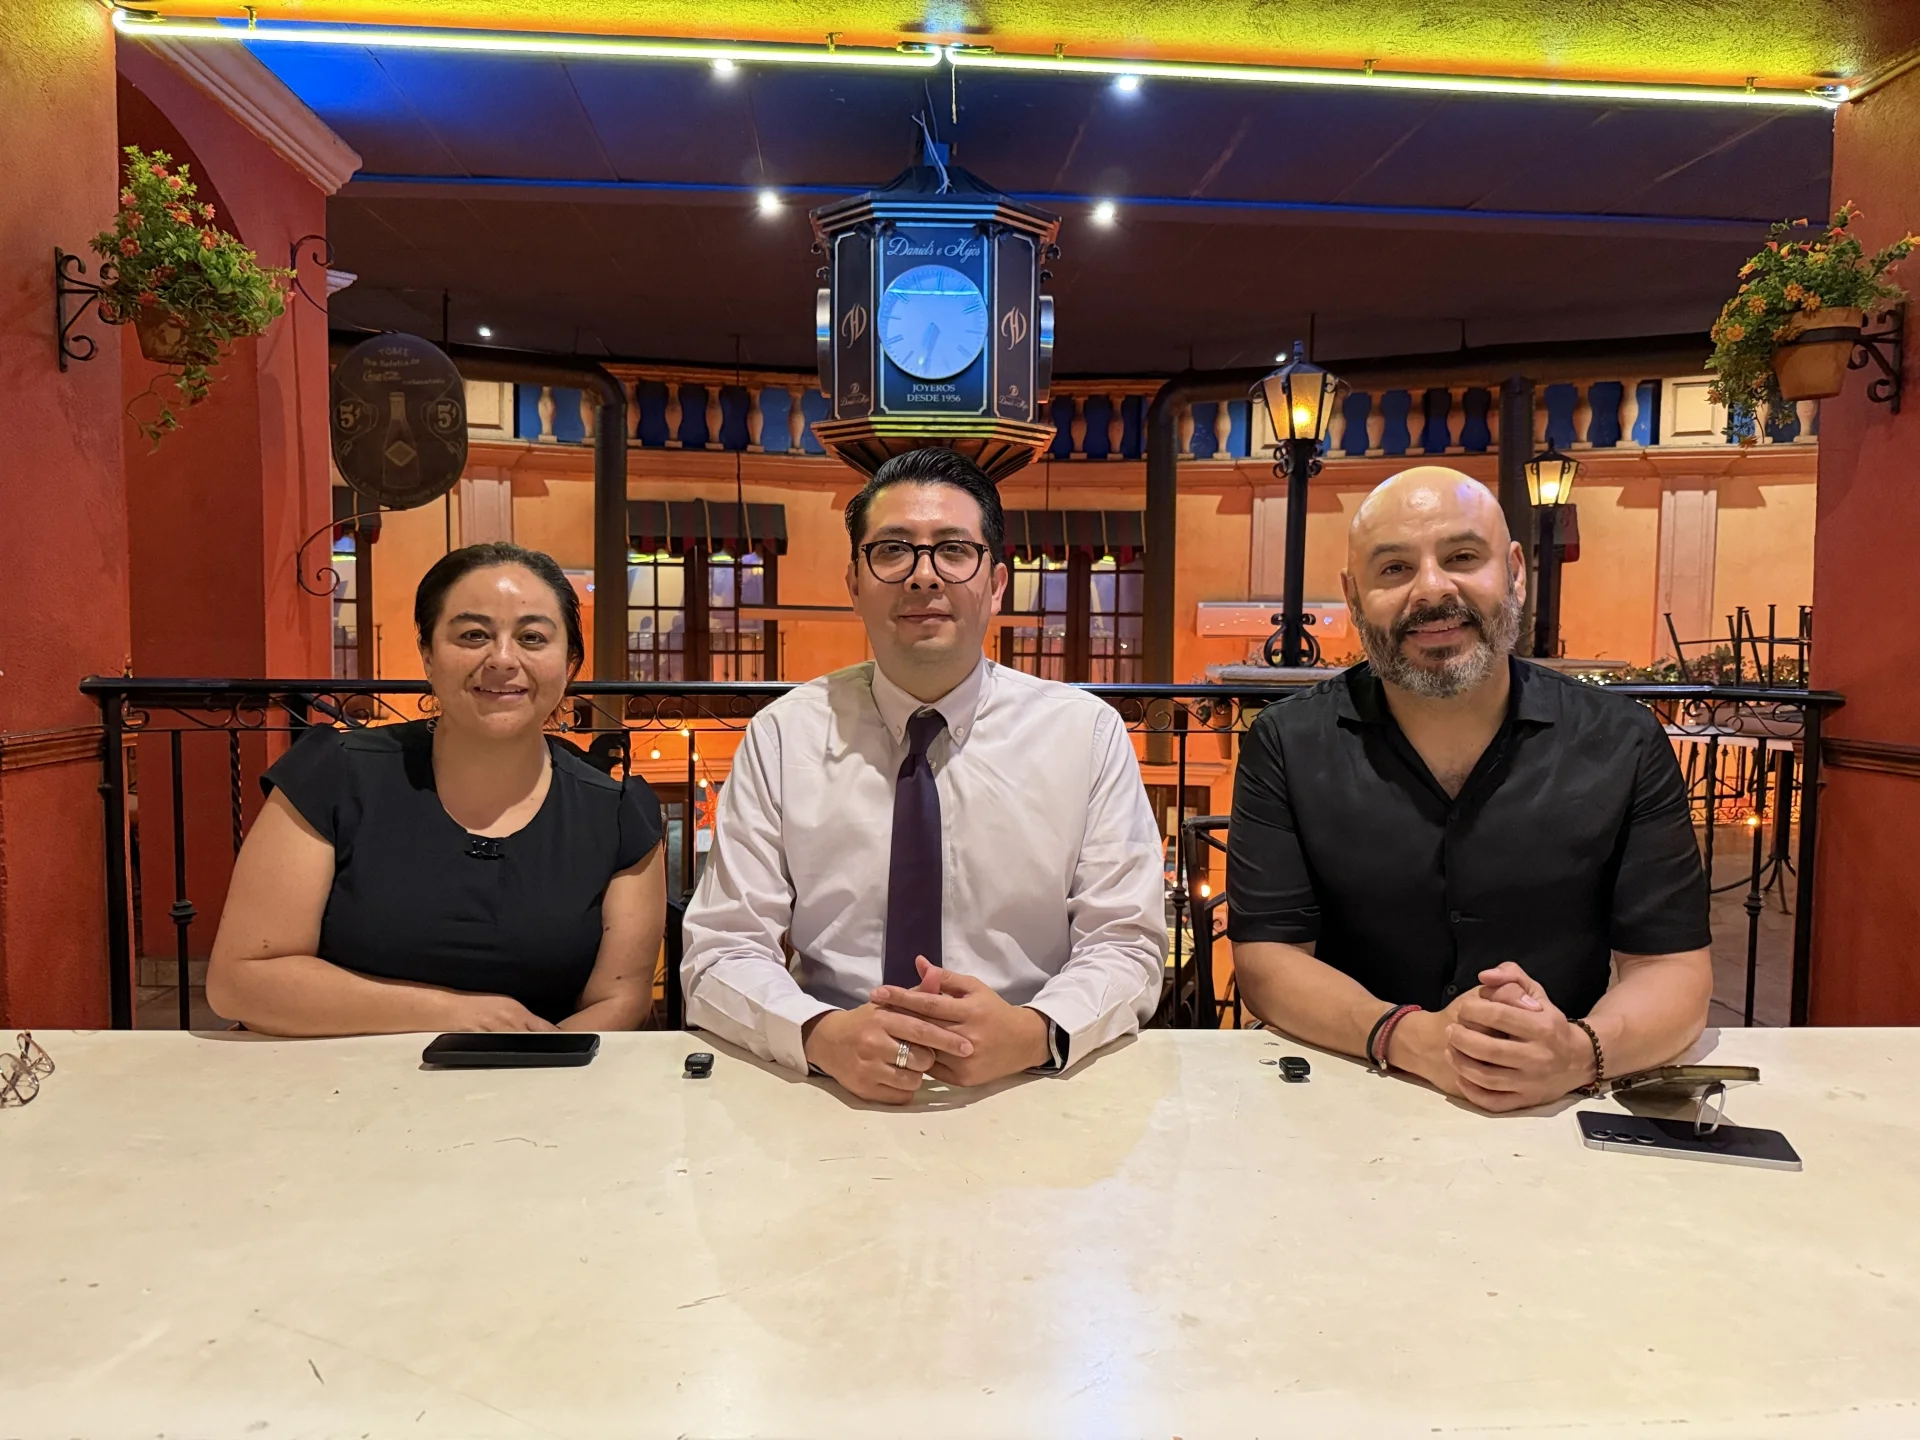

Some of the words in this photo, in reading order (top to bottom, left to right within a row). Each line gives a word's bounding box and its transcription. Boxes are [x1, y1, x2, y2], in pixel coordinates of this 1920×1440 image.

[912, 384, 956, 393] JOYEROS
[906, 393, 940, 402] DESDE
[940, 394, 962, 403] 1956
